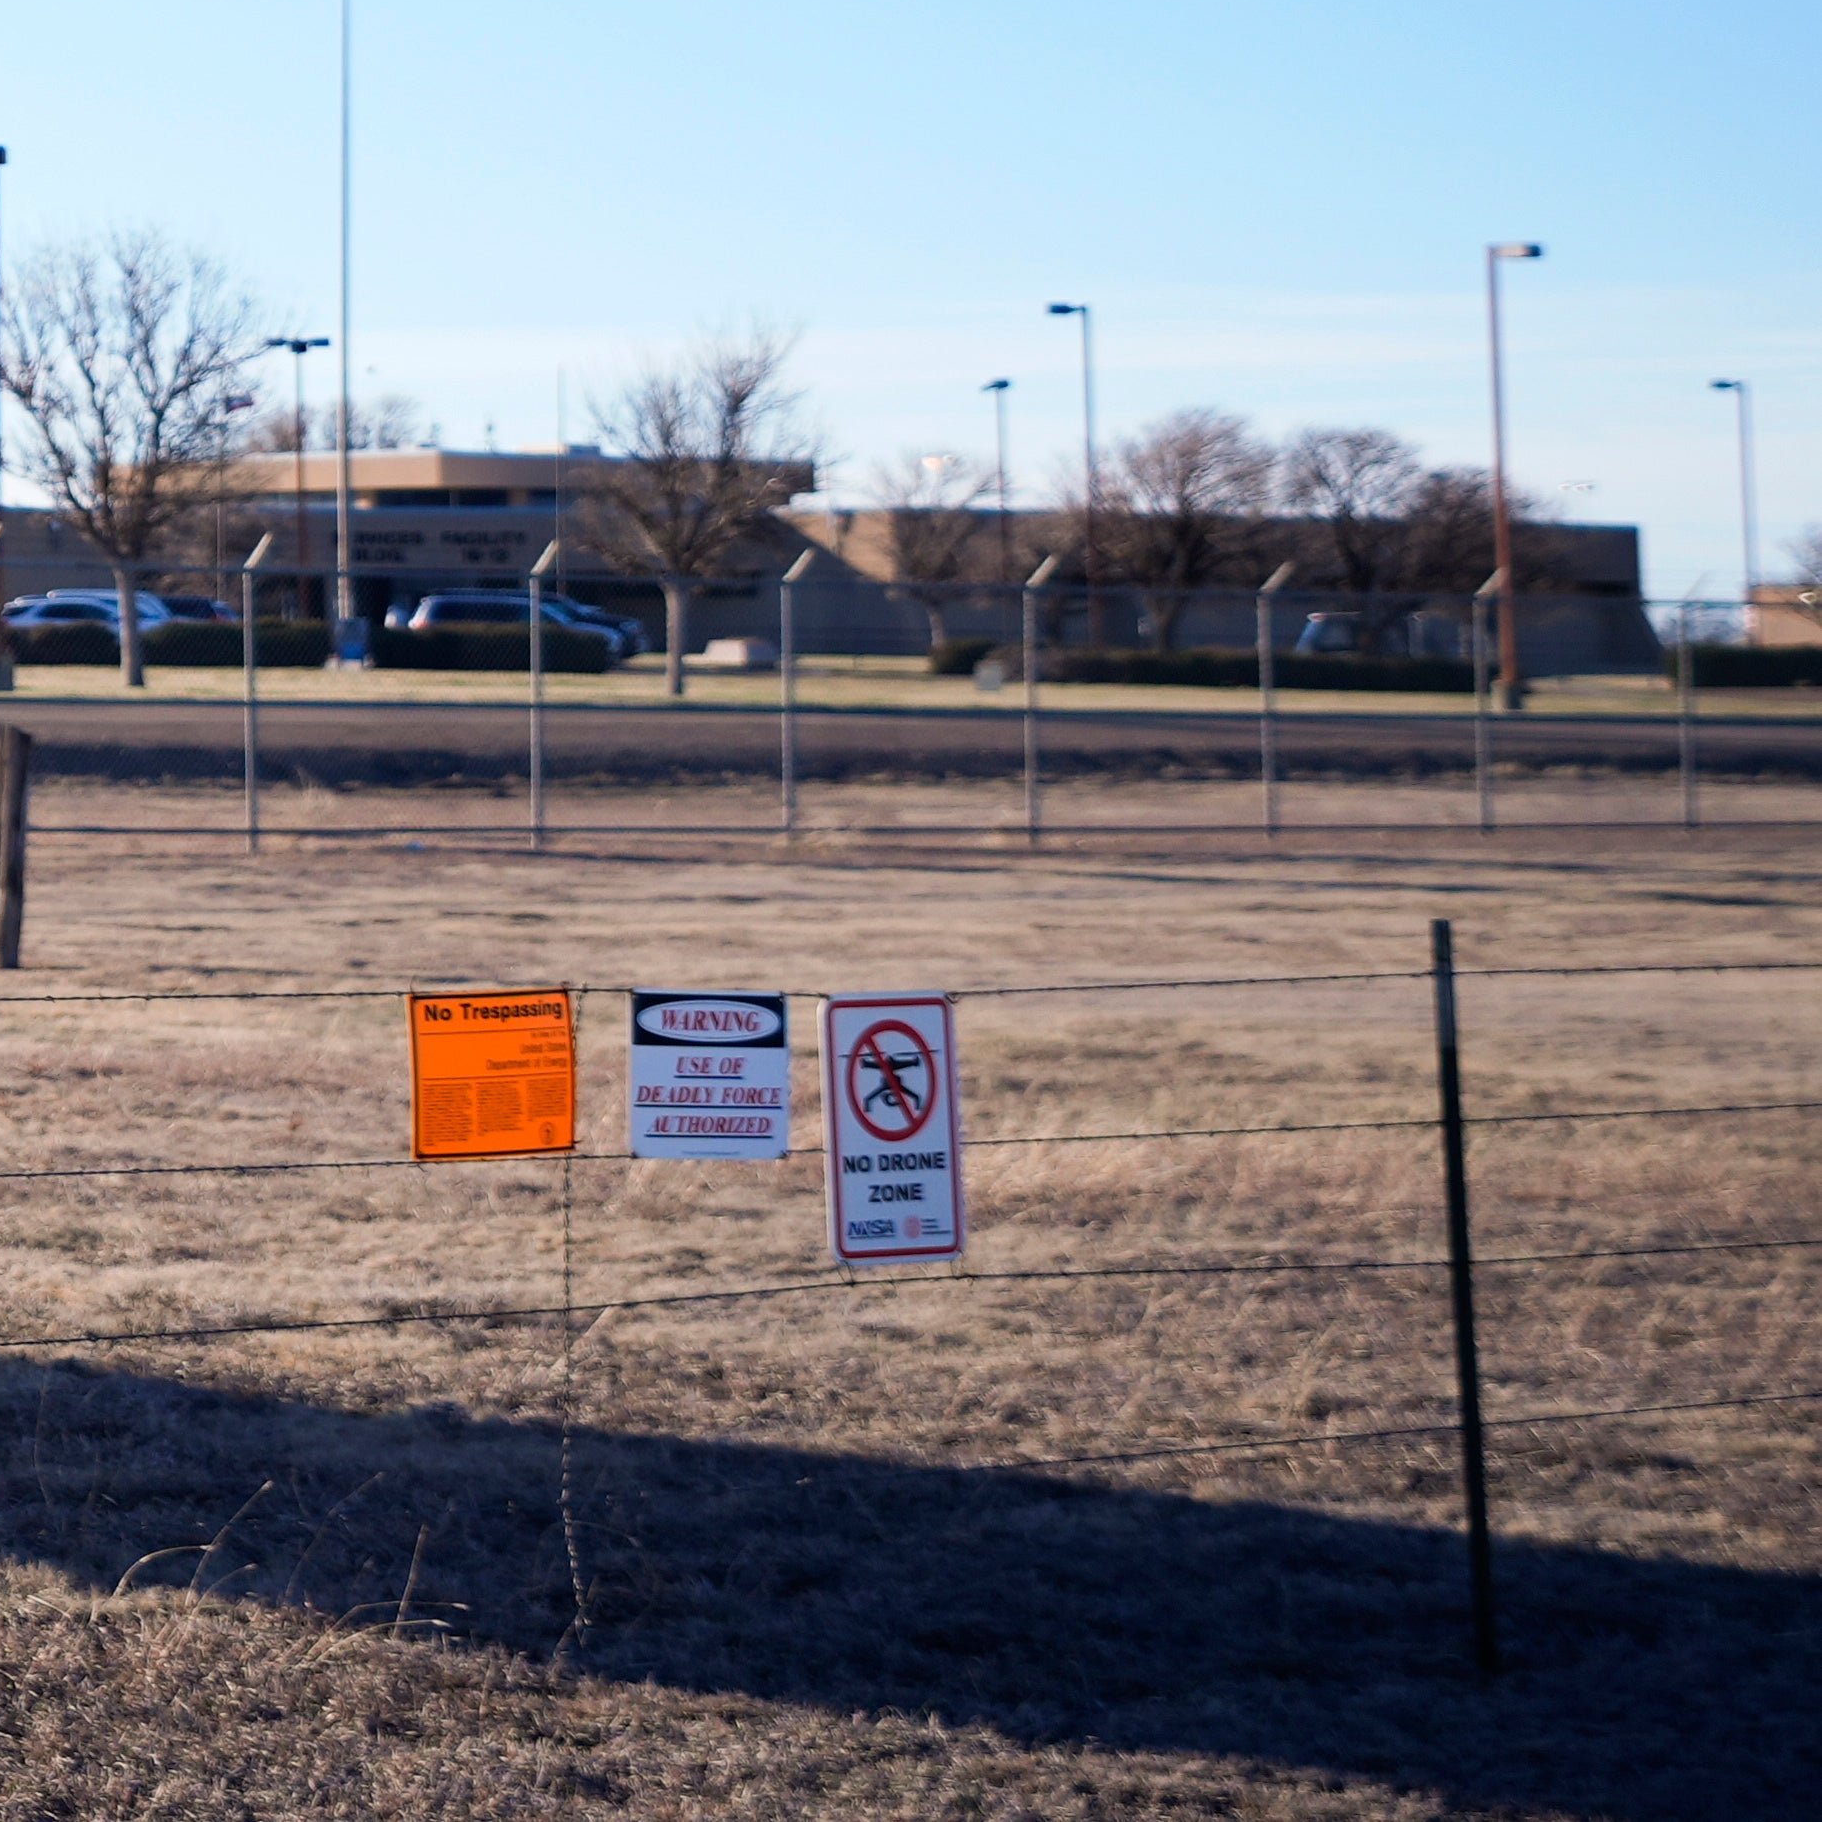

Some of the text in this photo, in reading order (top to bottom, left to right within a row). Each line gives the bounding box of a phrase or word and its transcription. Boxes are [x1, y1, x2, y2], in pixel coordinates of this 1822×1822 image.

[424, 1000, 562, 1023] No Trespassing
[660, 1009, 761, 1032] WARNING
[676, 1056, 746, 1074] USE OF
[636, 1085, 782, 1104] DEADLY FORCE
[648, 1115, 772, 1134] AUTHORIZED
[842, 1152, 945, 1173] NO DRONE
[868, 1183, 924, 1202] ZONE
